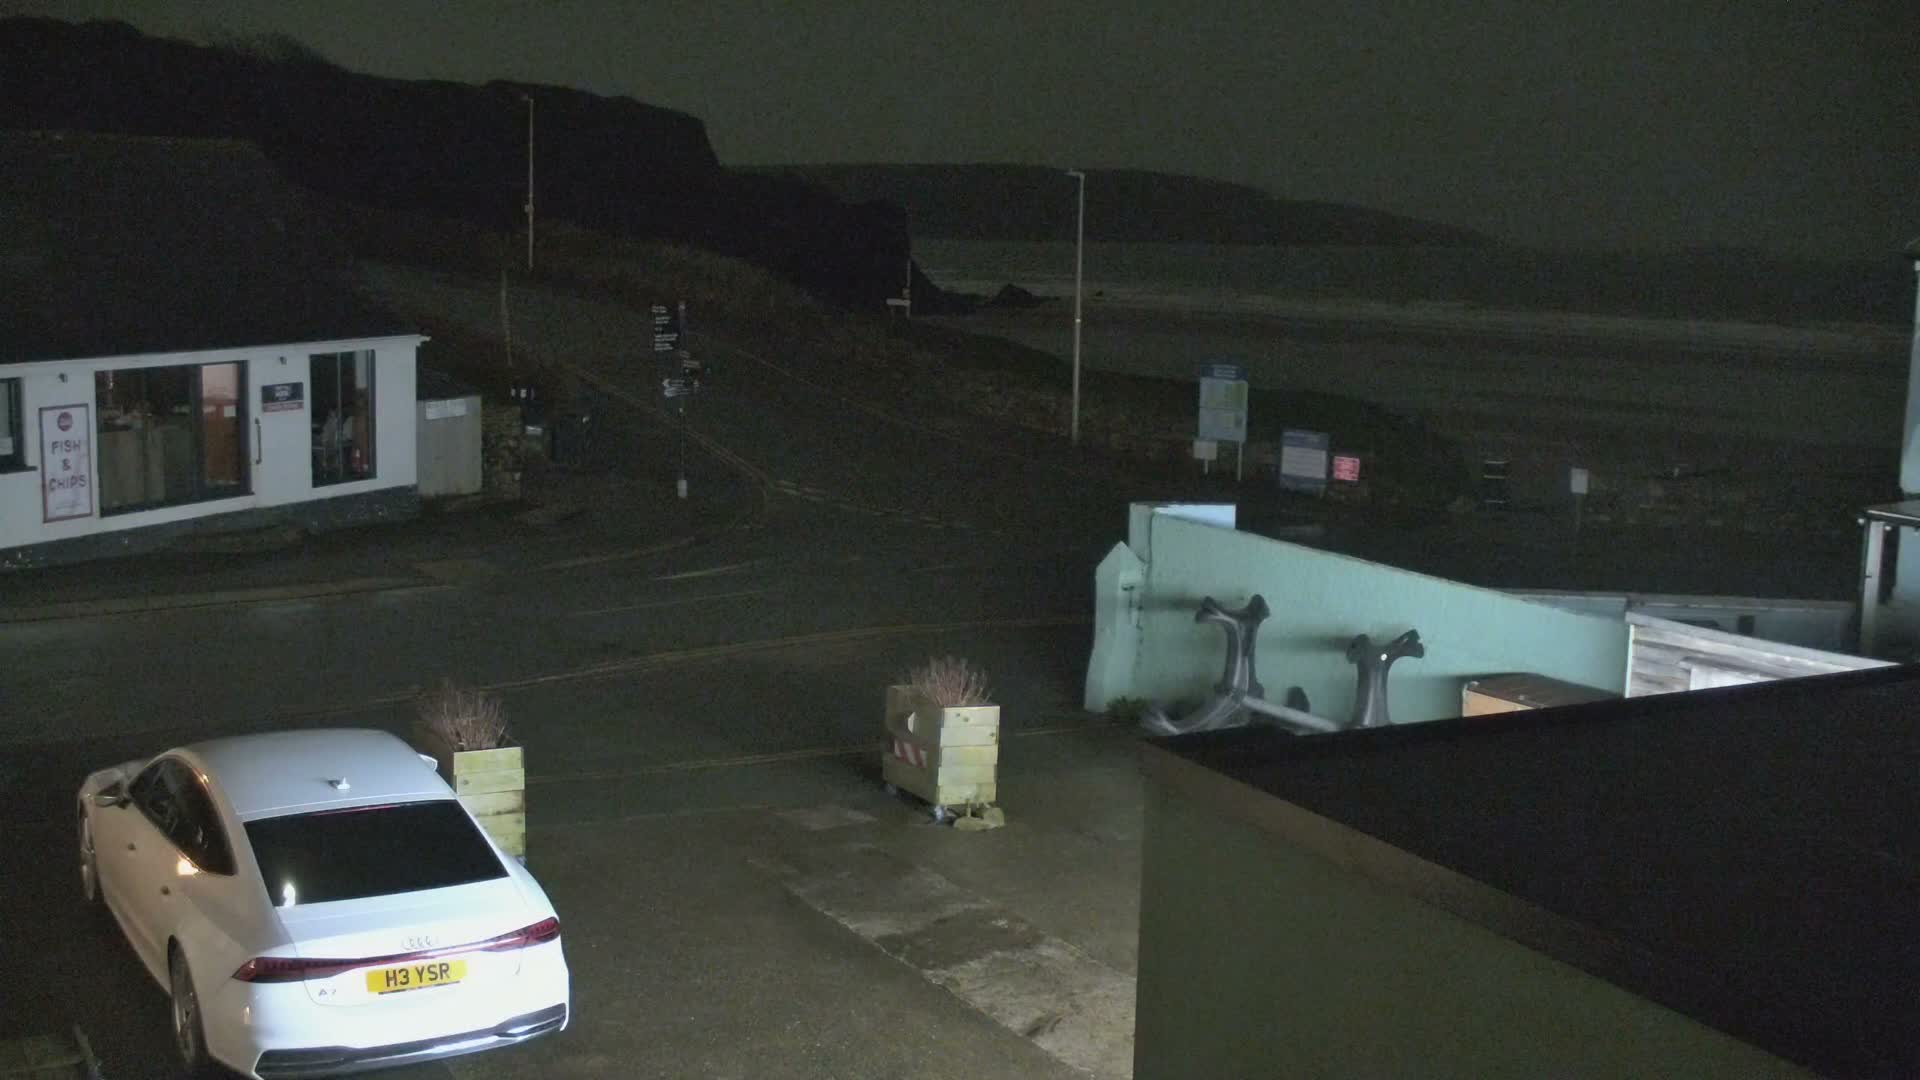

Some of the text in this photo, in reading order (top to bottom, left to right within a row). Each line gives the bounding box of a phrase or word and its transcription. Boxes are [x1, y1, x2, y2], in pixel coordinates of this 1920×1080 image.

[51, 440, 81, 455] FISH
[62, 458, 71, 471] &
[49, 475, 86, 492] CHIPS
[385, 962, 450, 987] H3 YSR
